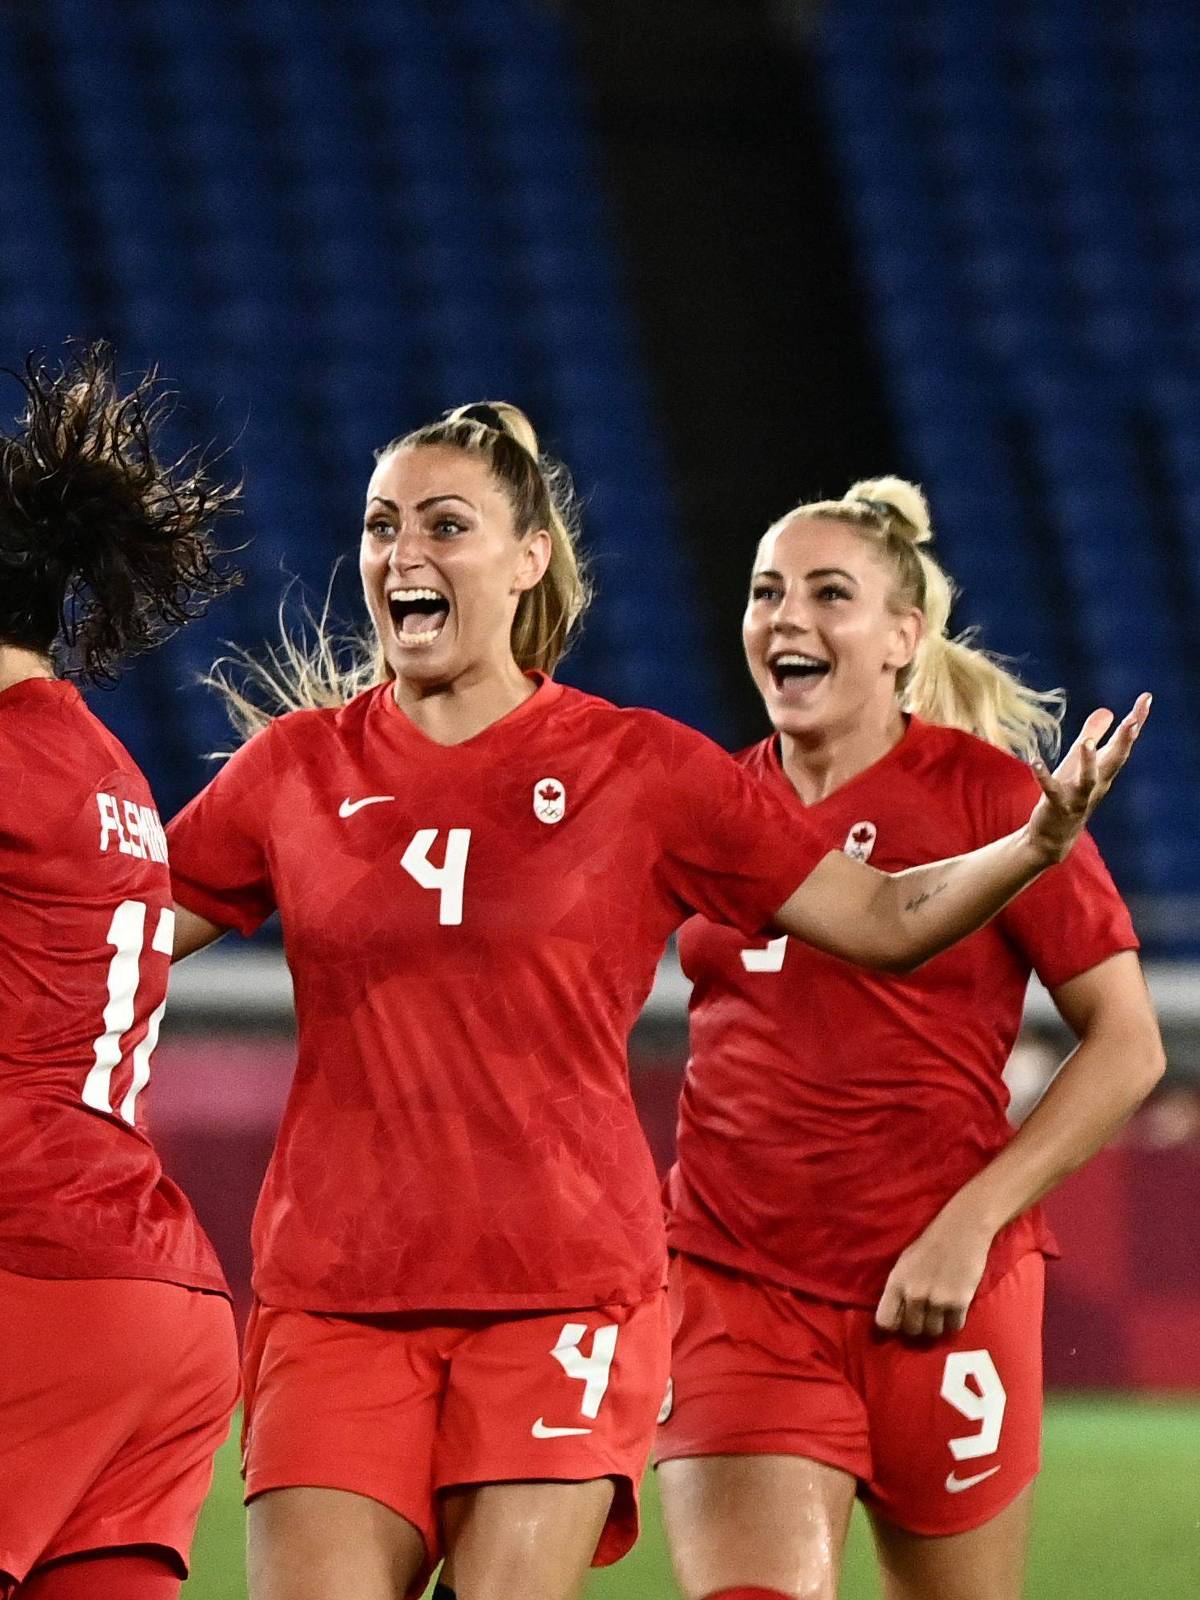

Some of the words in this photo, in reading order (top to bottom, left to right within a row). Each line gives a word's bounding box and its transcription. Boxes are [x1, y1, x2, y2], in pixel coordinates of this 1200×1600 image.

[400, 828, 471, 926] 4
[549, 1322, 619, 1420] 4
[940, 1349, 1007, 1461] 9
